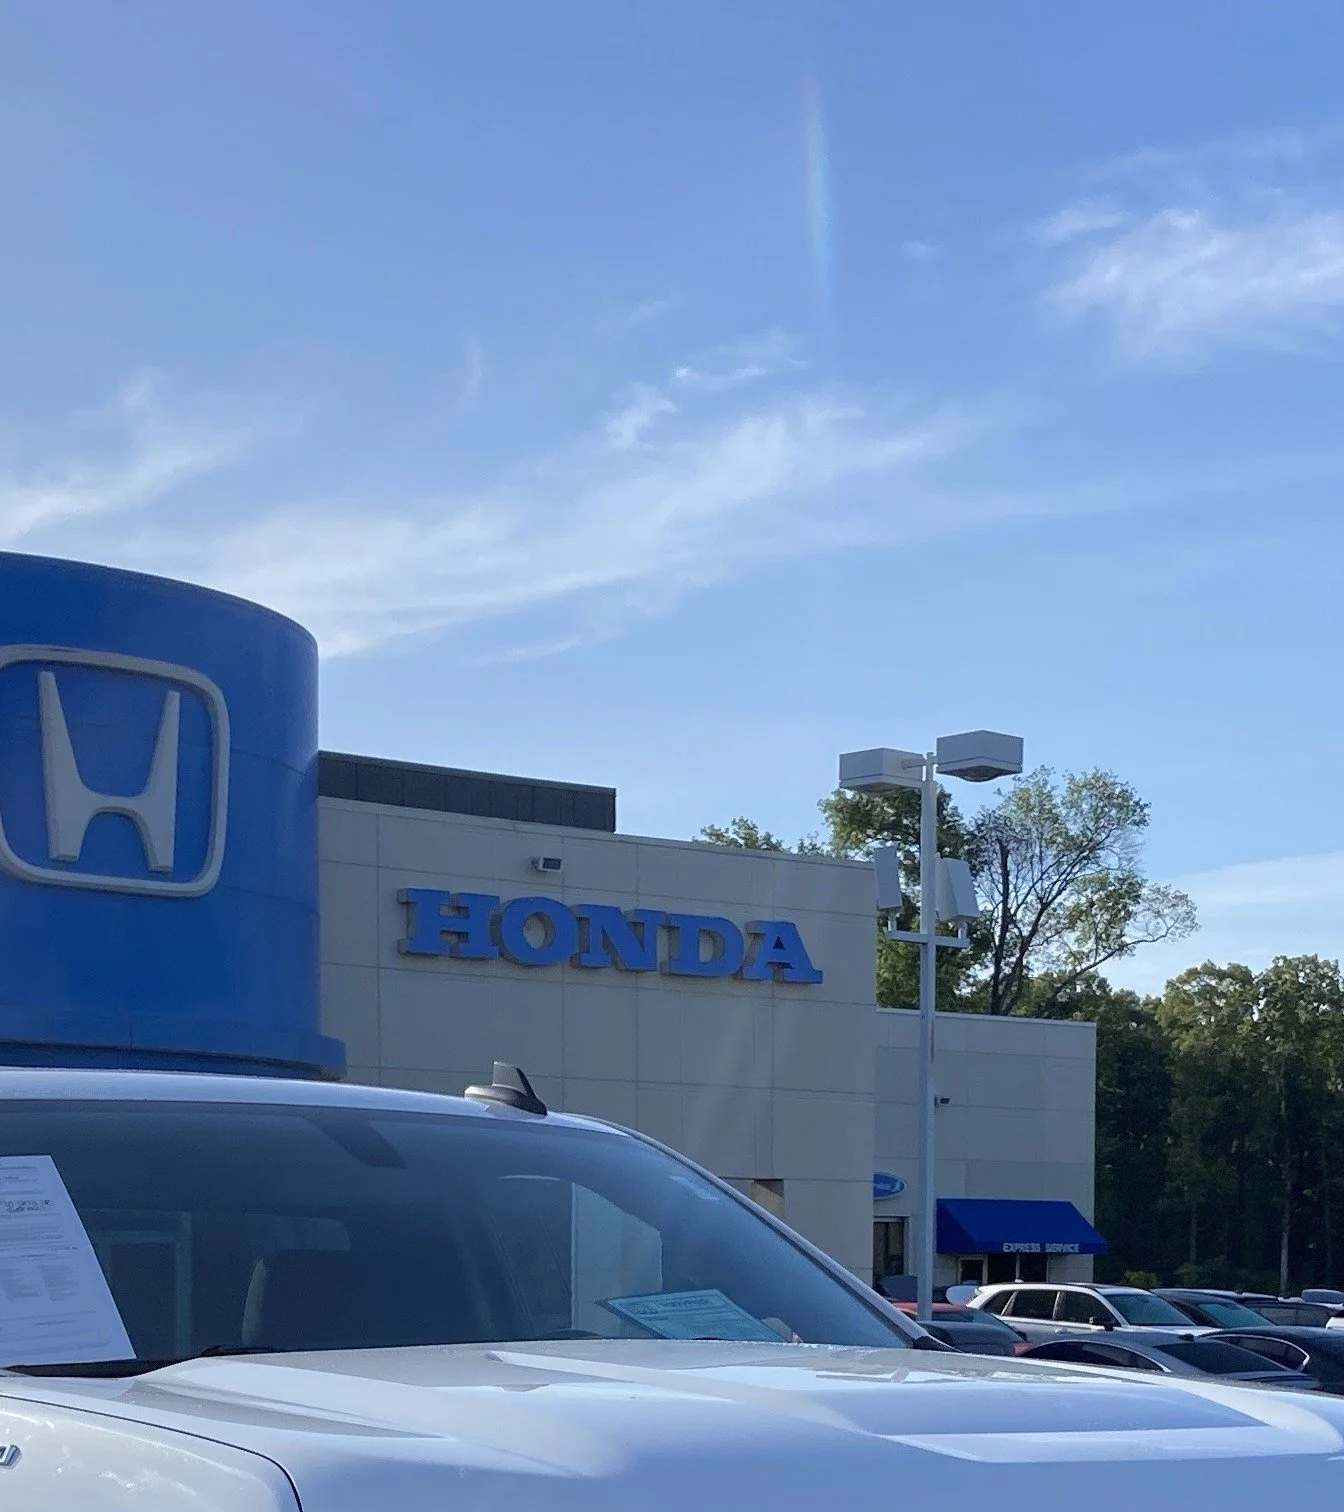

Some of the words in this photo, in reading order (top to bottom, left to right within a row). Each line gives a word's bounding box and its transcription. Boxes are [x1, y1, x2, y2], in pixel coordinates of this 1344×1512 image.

[397, 887, 823, 984] HONDA
[1002, 1242, 1041, 1252] EXPRESS
[1045, 1242, 1080, 1252] SERVICE
